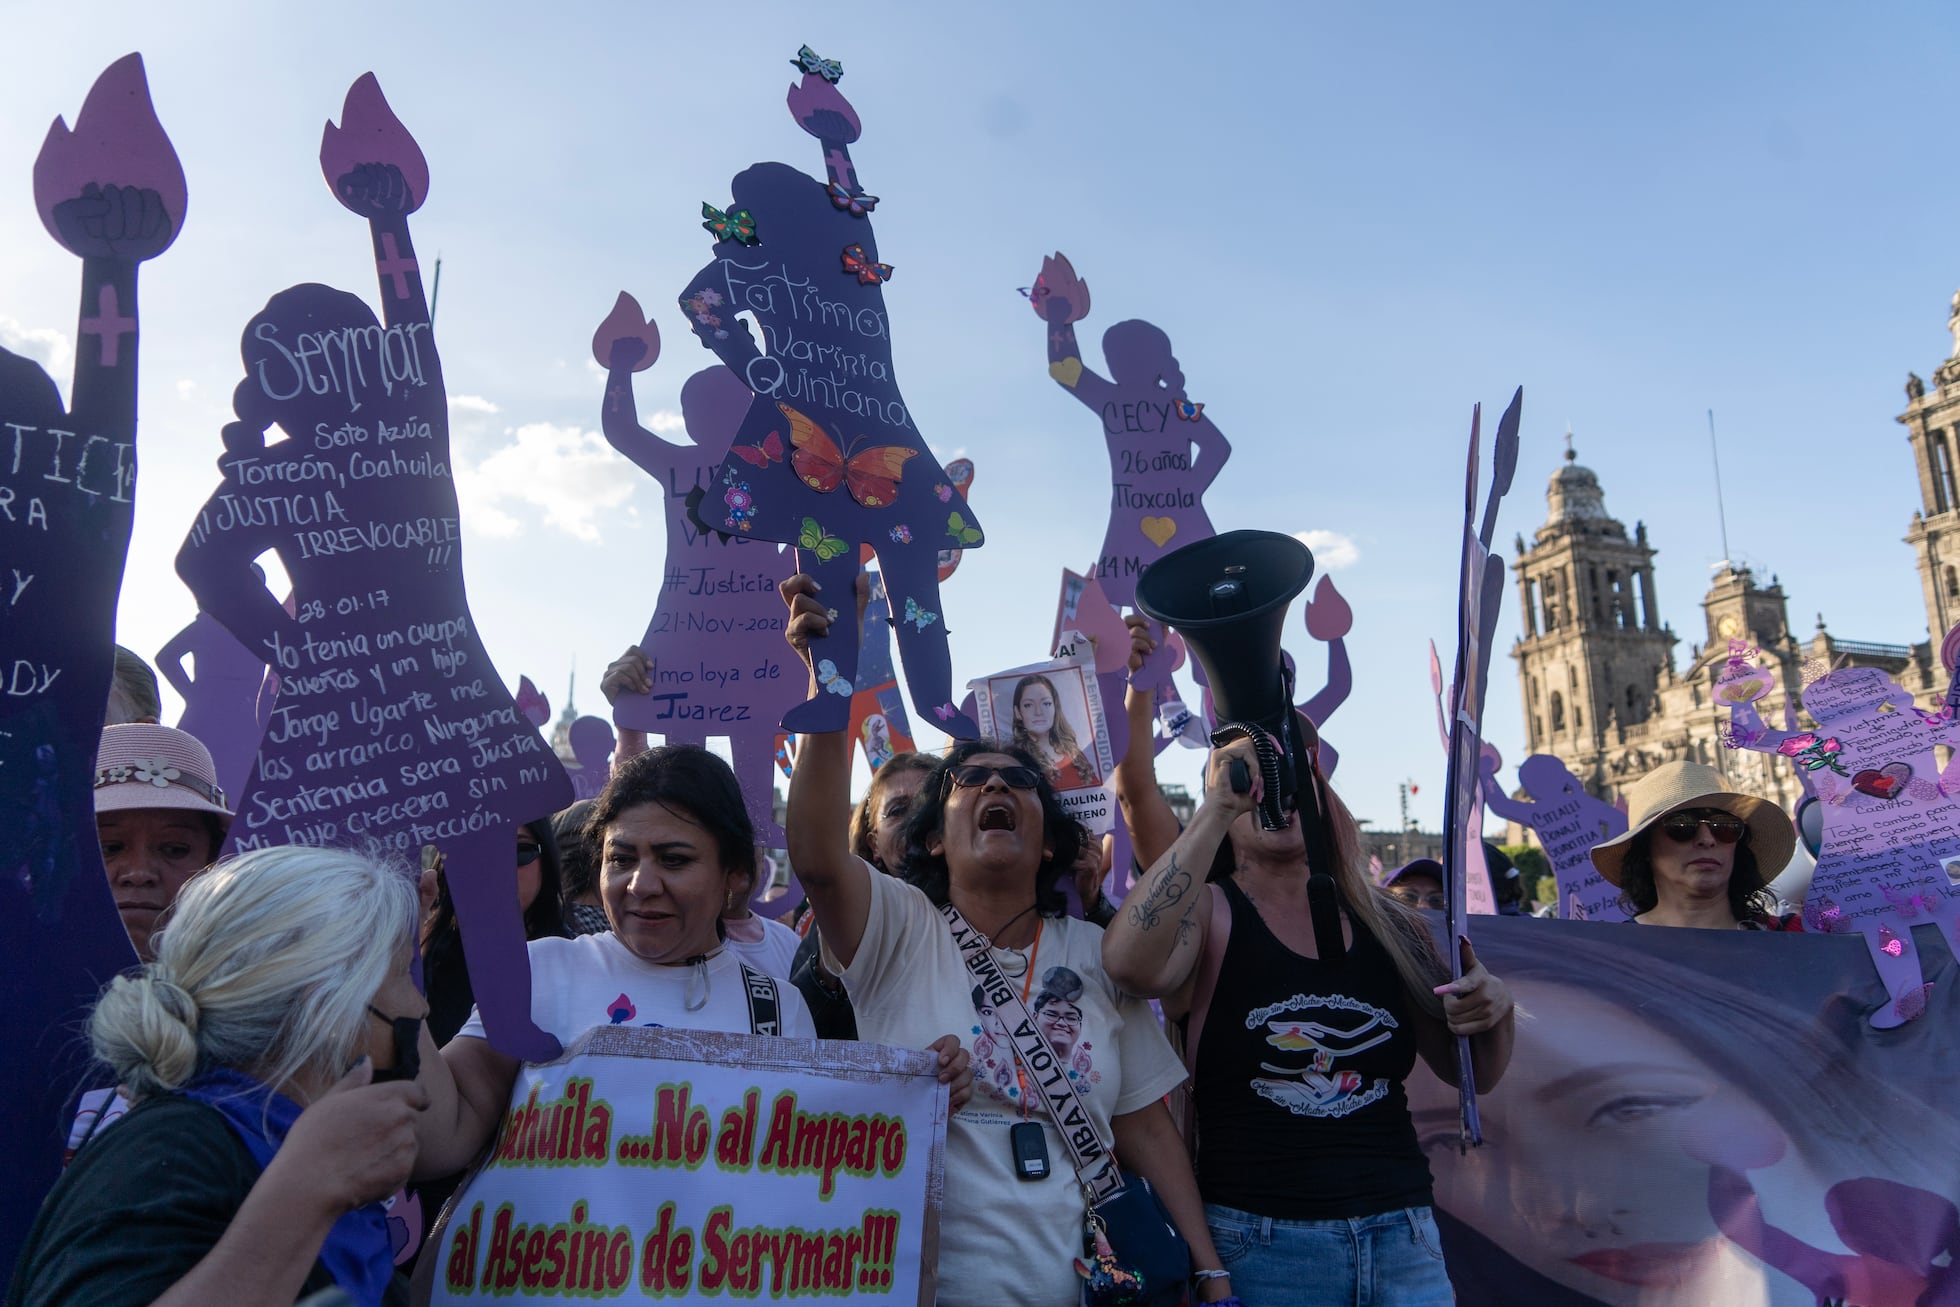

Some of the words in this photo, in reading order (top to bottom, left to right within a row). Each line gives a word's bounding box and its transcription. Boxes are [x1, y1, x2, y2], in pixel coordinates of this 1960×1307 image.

[254, 322, 430, 412] Serymar
[762, 325, 888, 382] Varinia
[746, 355, 912, 430] Quintana
[1102, 399, 1171, 435] CECY
[315, 421, 368, 450] Soto
[350, 450, 452, 480] Coahuila
[1120, 450, 1149, 474] 26
[1113, 483, 1196, 510] Tlaxcala
[294, 517, 460, 559] IRREVOCABLE
[664, 567, 774, 596] #Justicia
[1097, 556, 1119, 578] 14
[264, 631, 299, 670] Yo
[377, 628, 403, 650] un
[370, 664, 387, 695] y
[392, 656, 419, 677] un
[433, 648, 468, 678] hijo
[754, 659, 780, 680] de
[269, 703, 340, 746] Jorge
[350, 691, 437, 737] Ugarte
[451, 679, 488, 701] me
[653, 692, 752, 722] Juarez
[259, 749, 293, 782] los
[424, 706, 519, 746] Ninguna
[1867, 724, 1886, 735] de
[246, 776, 389, 828] Sentencia
[472, 733, 540, 768] Justa
[468, 773, 506, 799] sin
[519, 762, 549, 785] mi
[1823, 823, 1867, 838] Todo
[1926, 803, 1960, 819] para
[1880, 822, 1926, 839] cuando
[1931, 814, 1948, 824] tu
[1889, 846, 1906, 857] de
[1013, 1018, 1064, 1089] LOLA
[1049, 1092, 1073, 1113] Y
[714, 1086, 762, 1169] al
[759, 1088, 909, 1201] Amparo
[445, 1201, 483, 1296] al
[482, 1198, 634, 1297] Asesino
[639, 1200, 695, 1295] de
[697, 1203, 901, 1299] Serymar!!!
